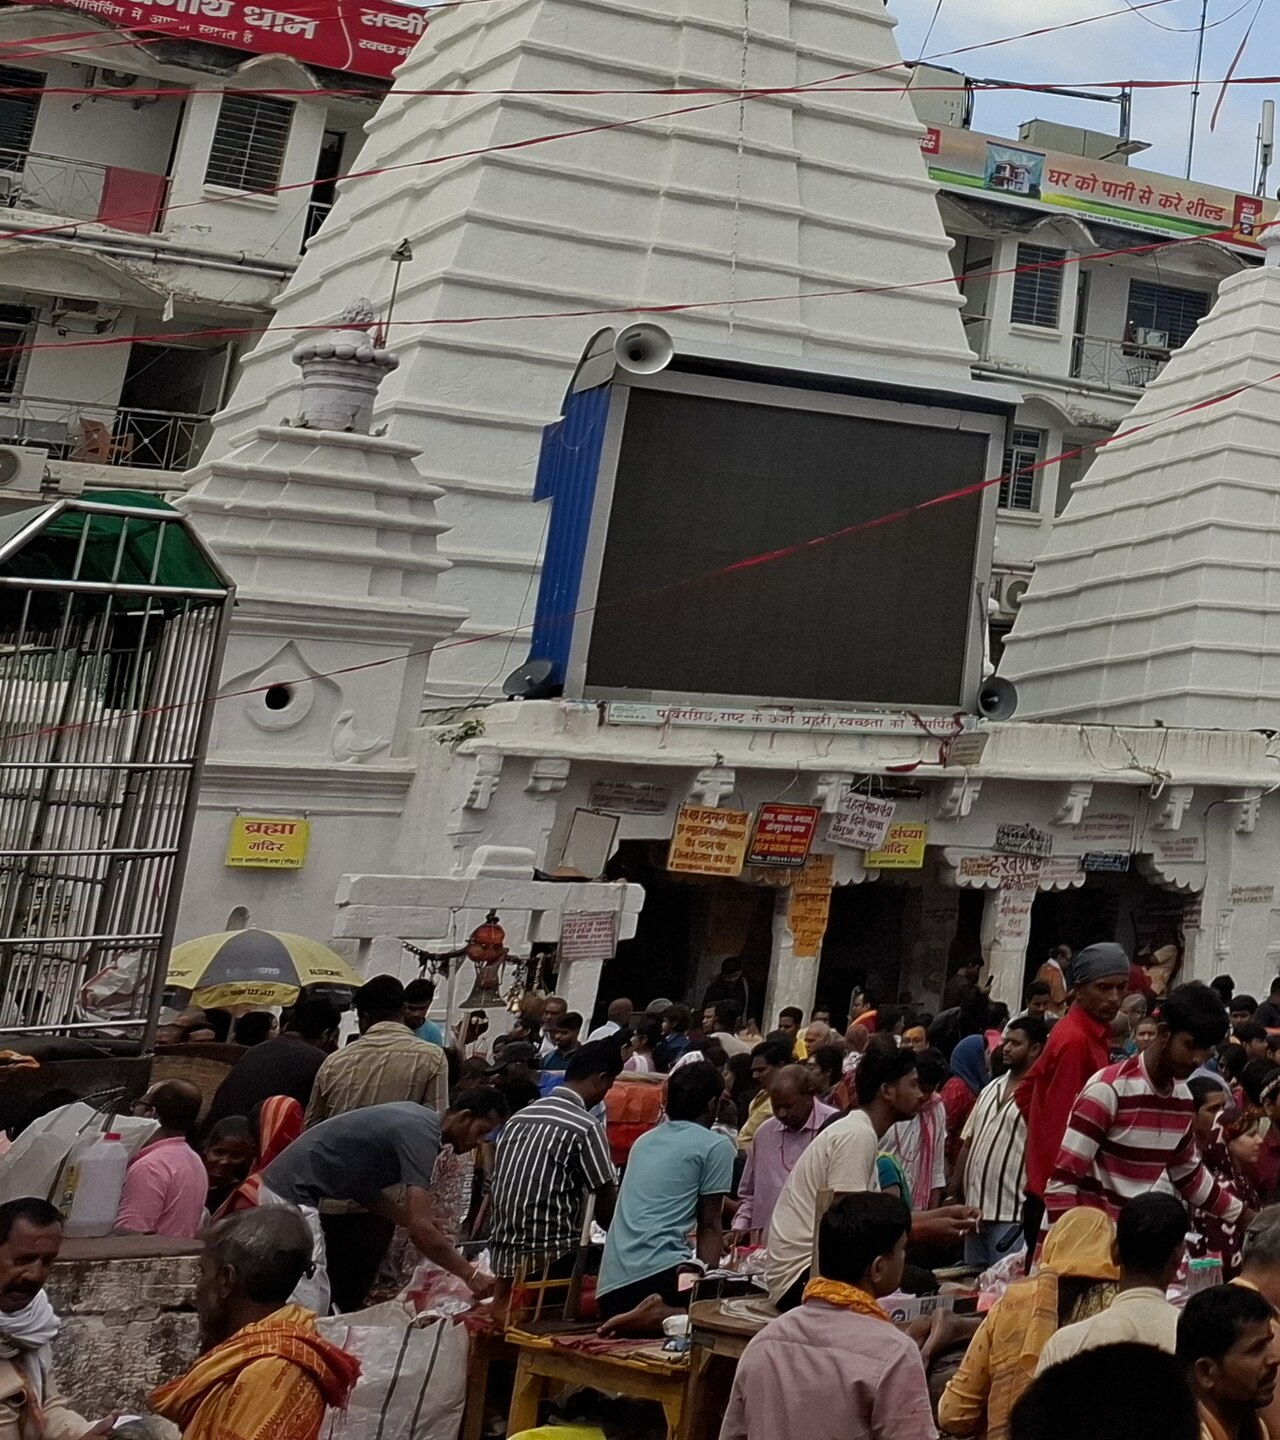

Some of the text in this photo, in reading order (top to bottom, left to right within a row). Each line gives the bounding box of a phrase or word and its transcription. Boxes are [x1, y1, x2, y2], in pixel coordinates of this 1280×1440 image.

[131, 7, 143, 21] में
[243, 6, 320, 40] धाम
[1048, 169, 1072, 187] घर
[1075, 173, 1099, 194] को
[1102, 180, 1137, 202] पानी
[1138, 185, 1154, 205] से
[1186, 197, 1226, 222] शील्ड
[245, 822, 297, 836] ब्रह्मा
